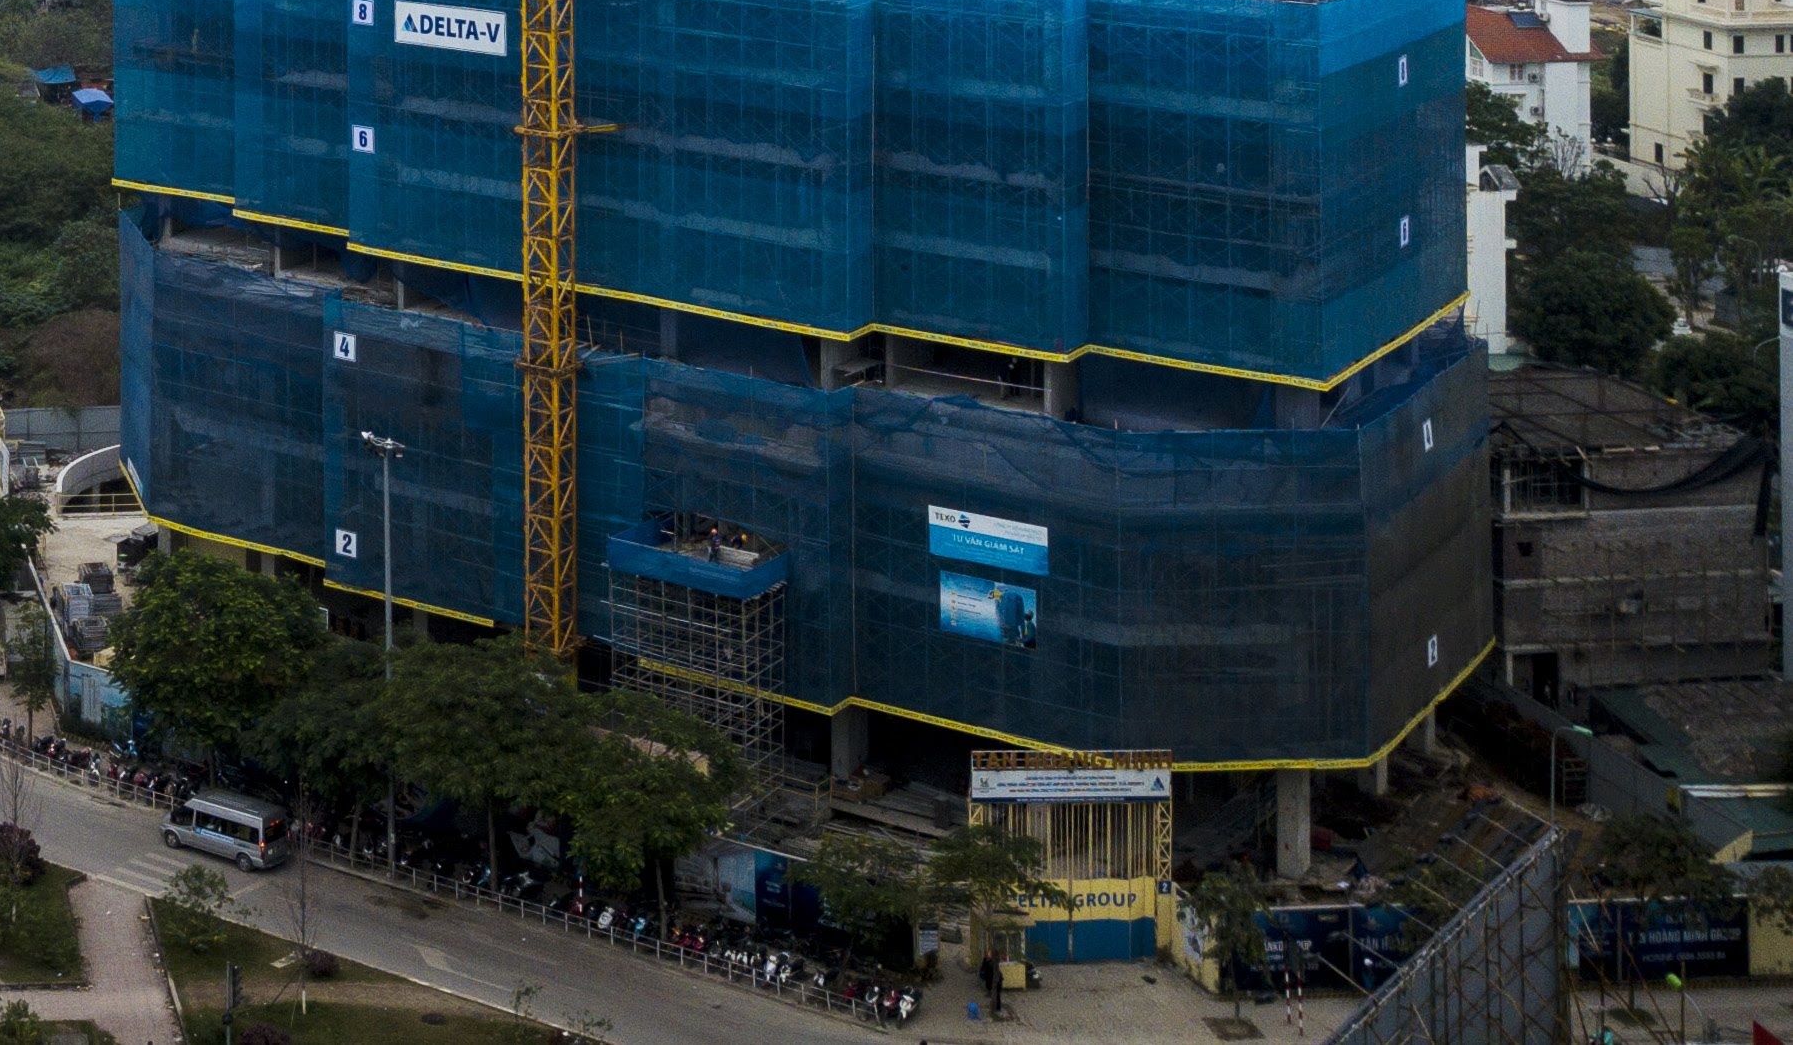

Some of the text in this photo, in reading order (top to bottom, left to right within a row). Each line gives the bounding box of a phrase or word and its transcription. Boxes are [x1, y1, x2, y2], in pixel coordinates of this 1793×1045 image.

[358, 3, 367, 20] 8
[419, 14, 500, 43] DELTA-V
[359, 130, 368, 147] 6
[339, 336, 350, 357] 4
[342, 533, 352, 554] 2
[1073, 892, 1137, 909] GROUP
